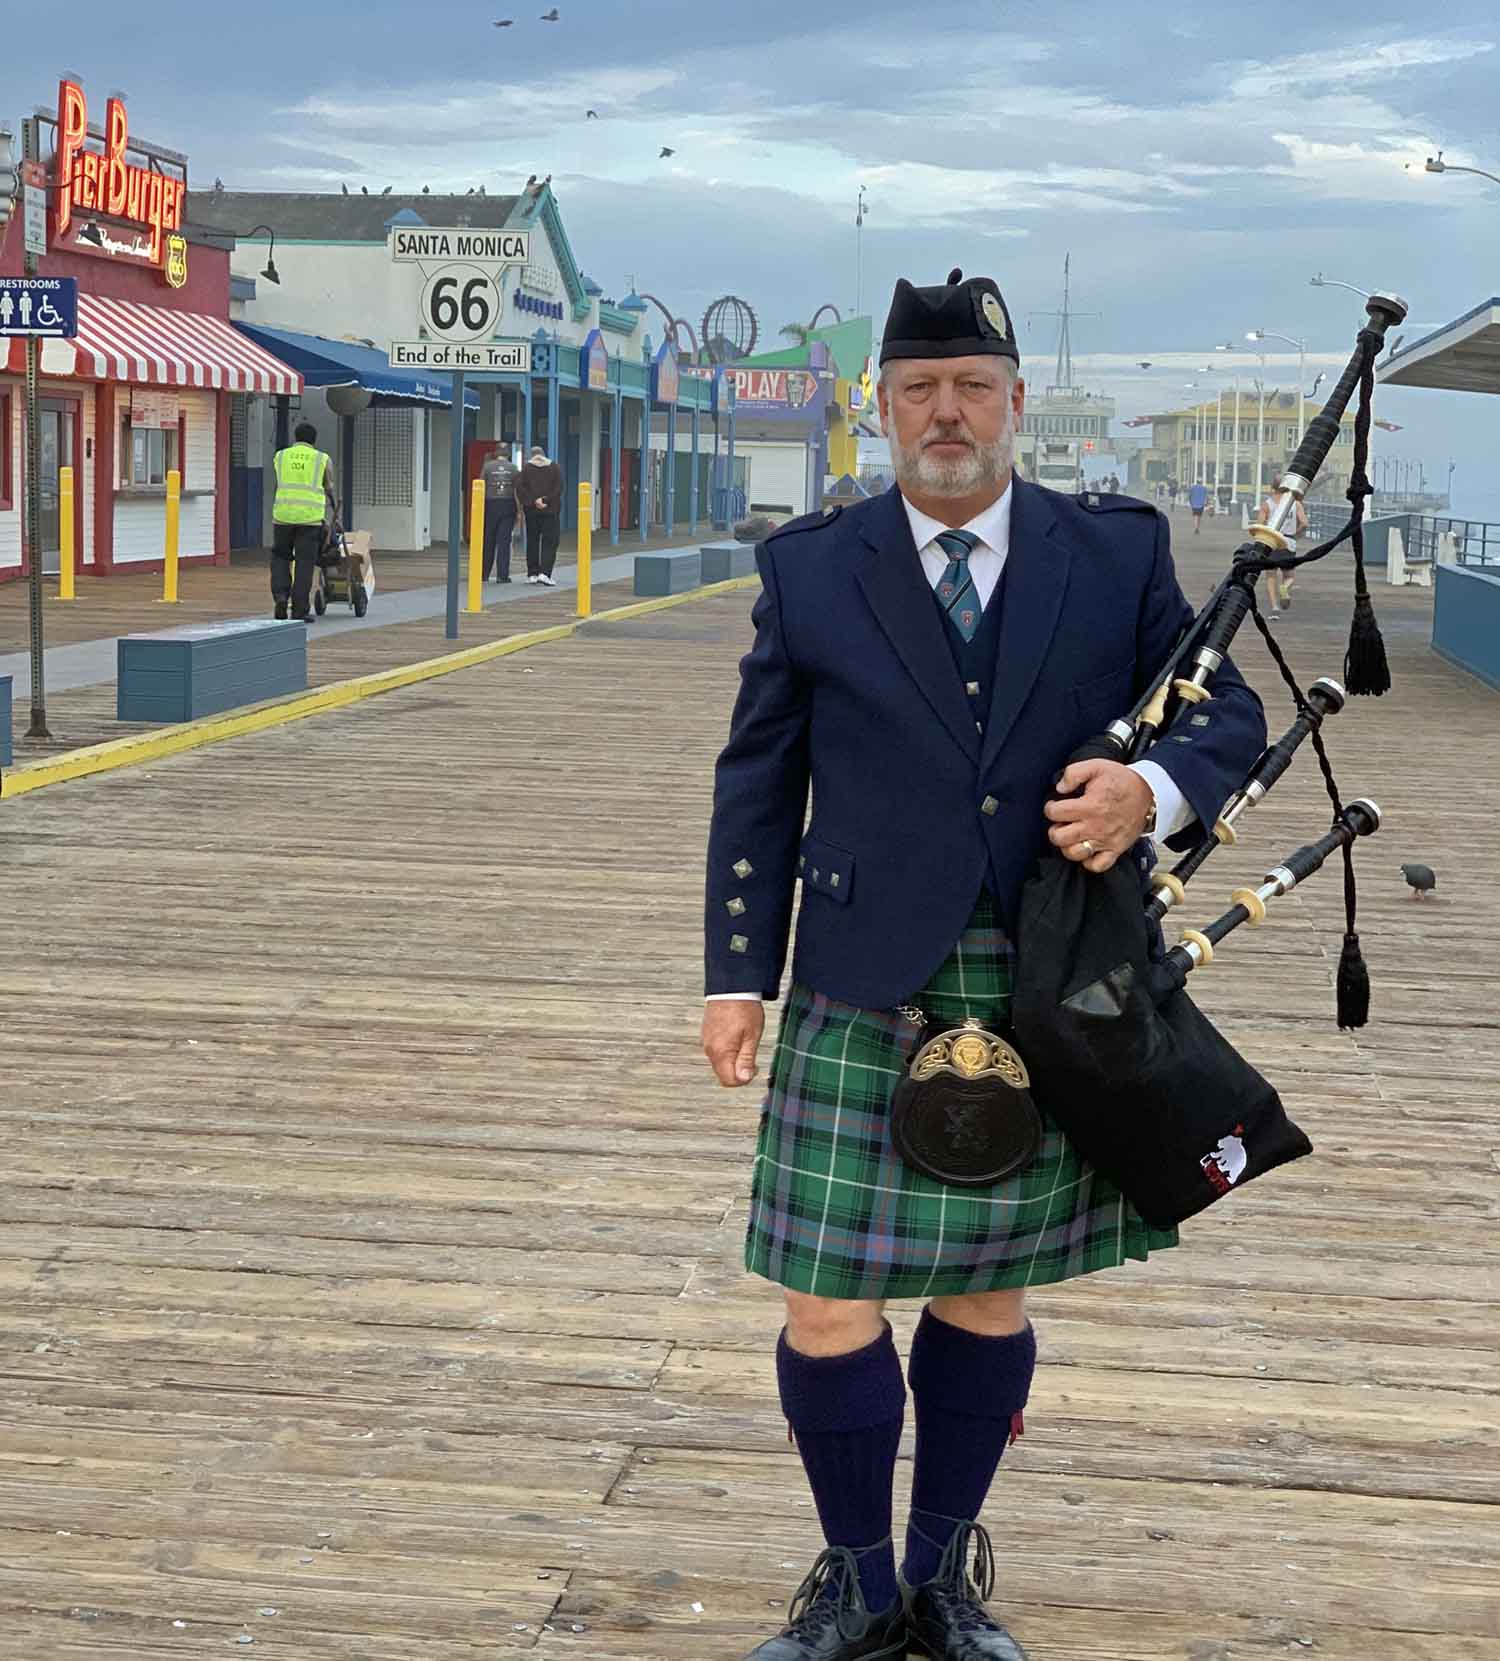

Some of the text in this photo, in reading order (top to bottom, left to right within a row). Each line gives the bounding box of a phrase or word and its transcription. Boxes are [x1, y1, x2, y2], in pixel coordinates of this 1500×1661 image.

[397, 233, 525, 258] SANTA MONICA
[0, 279, 62, 289] RESTROOMS
[430, 276, 490, 332] 66
[397, 346, 522, 366] End of the Trail
[735, 371, 781, 400] PLAY
